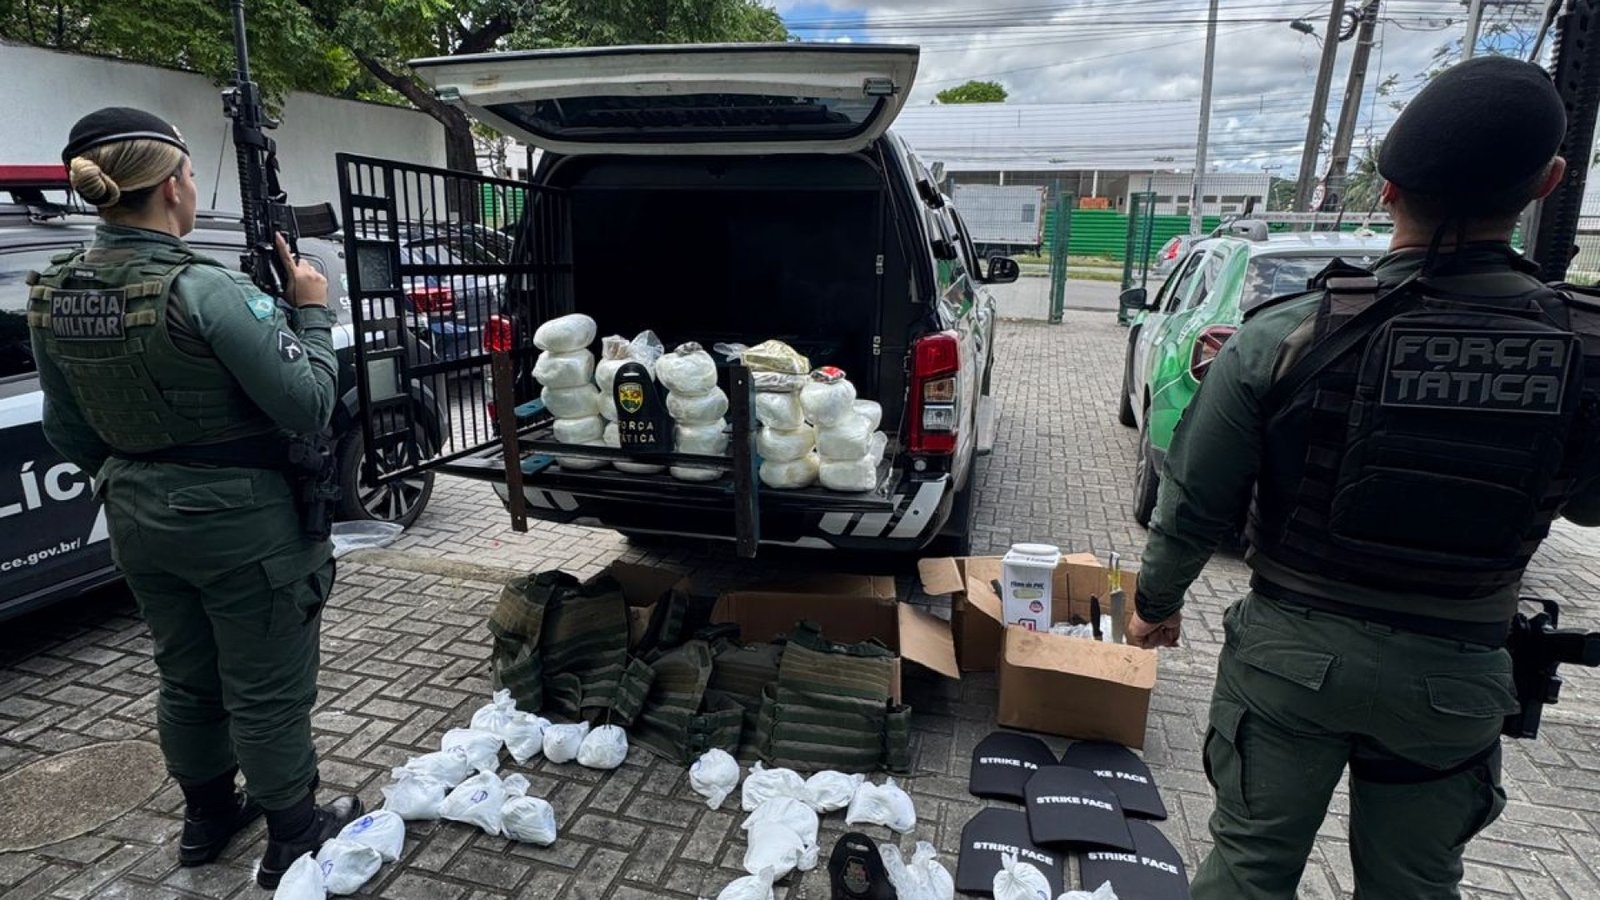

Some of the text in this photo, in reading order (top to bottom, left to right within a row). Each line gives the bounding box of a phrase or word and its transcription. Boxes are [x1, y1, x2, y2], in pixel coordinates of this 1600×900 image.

[52, 291, 121, 315] POLÍCIA
[53, 315, 120, 336] MILITAR
[1393, 335, 1566, 369] FORÇA
[1391, 365, 1560, 406] TÁTICA
[979, 757, 1038, 770] STRIKE FA
[1093, 770, 1148, 784] KE FACE
[1036, 796, 1113, 811] STRIKE FACE
[972, 841, 1054, 866] STRIKE FACE
[1088, 851, 1179, 875] STRIKE FACE
